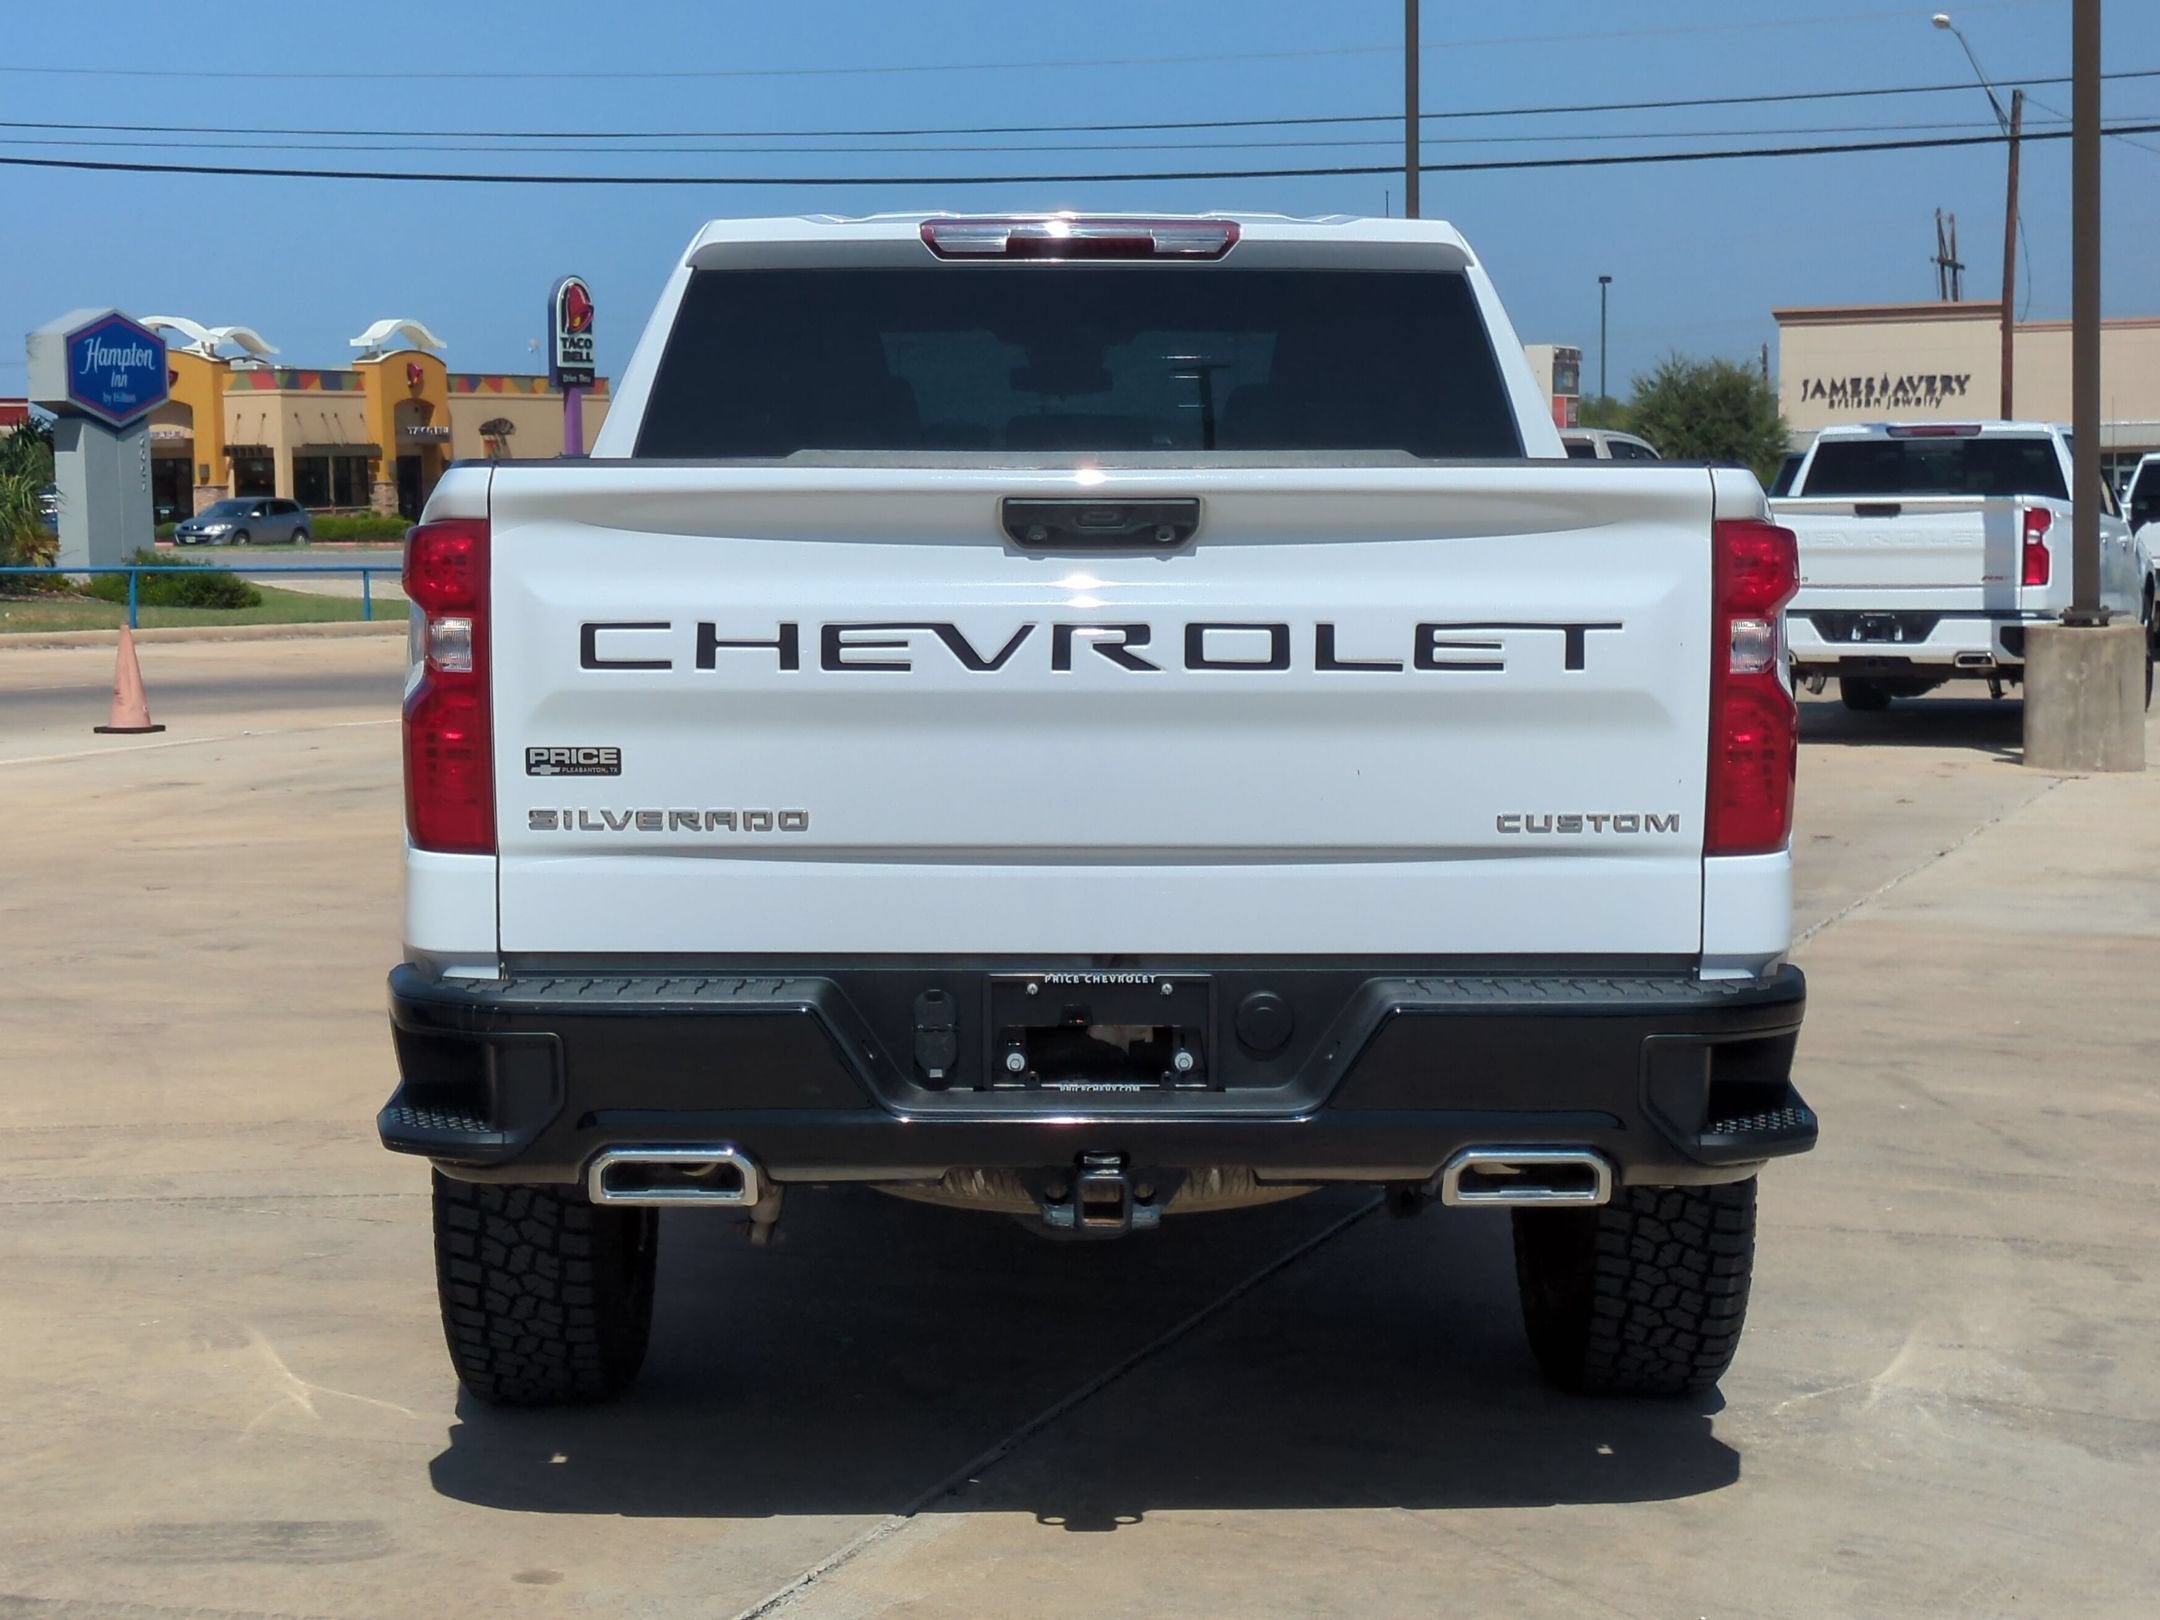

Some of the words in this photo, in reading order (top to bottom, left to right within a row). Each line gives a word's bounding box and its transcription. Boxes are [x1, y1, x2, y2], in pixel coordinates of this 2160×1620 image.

[560, 337, 593, 350] TACO
[80, 336, 156, 375] Hampton
[562, 350, 594, 363] BELL
[110, 370, 128, 388] Inn
[1801, 376, 1875, 402] JAMES
[1892, 373, 1971, 397] AVERY
[1828, 396, 1881, 409] artisan
[1886, 395, 1942, 410] jewelry
[580, 622, 1623, 671] CHEVROLET
[529, 748, 618, 764] PRICE
[528, 809, 809, 832] SILVERADO
[1496, 814, 1680, 833] CUSTOM
[1044, 975, 1080, 983] PRICE
[1084, 975, 1156, 983] CHEVROLET
